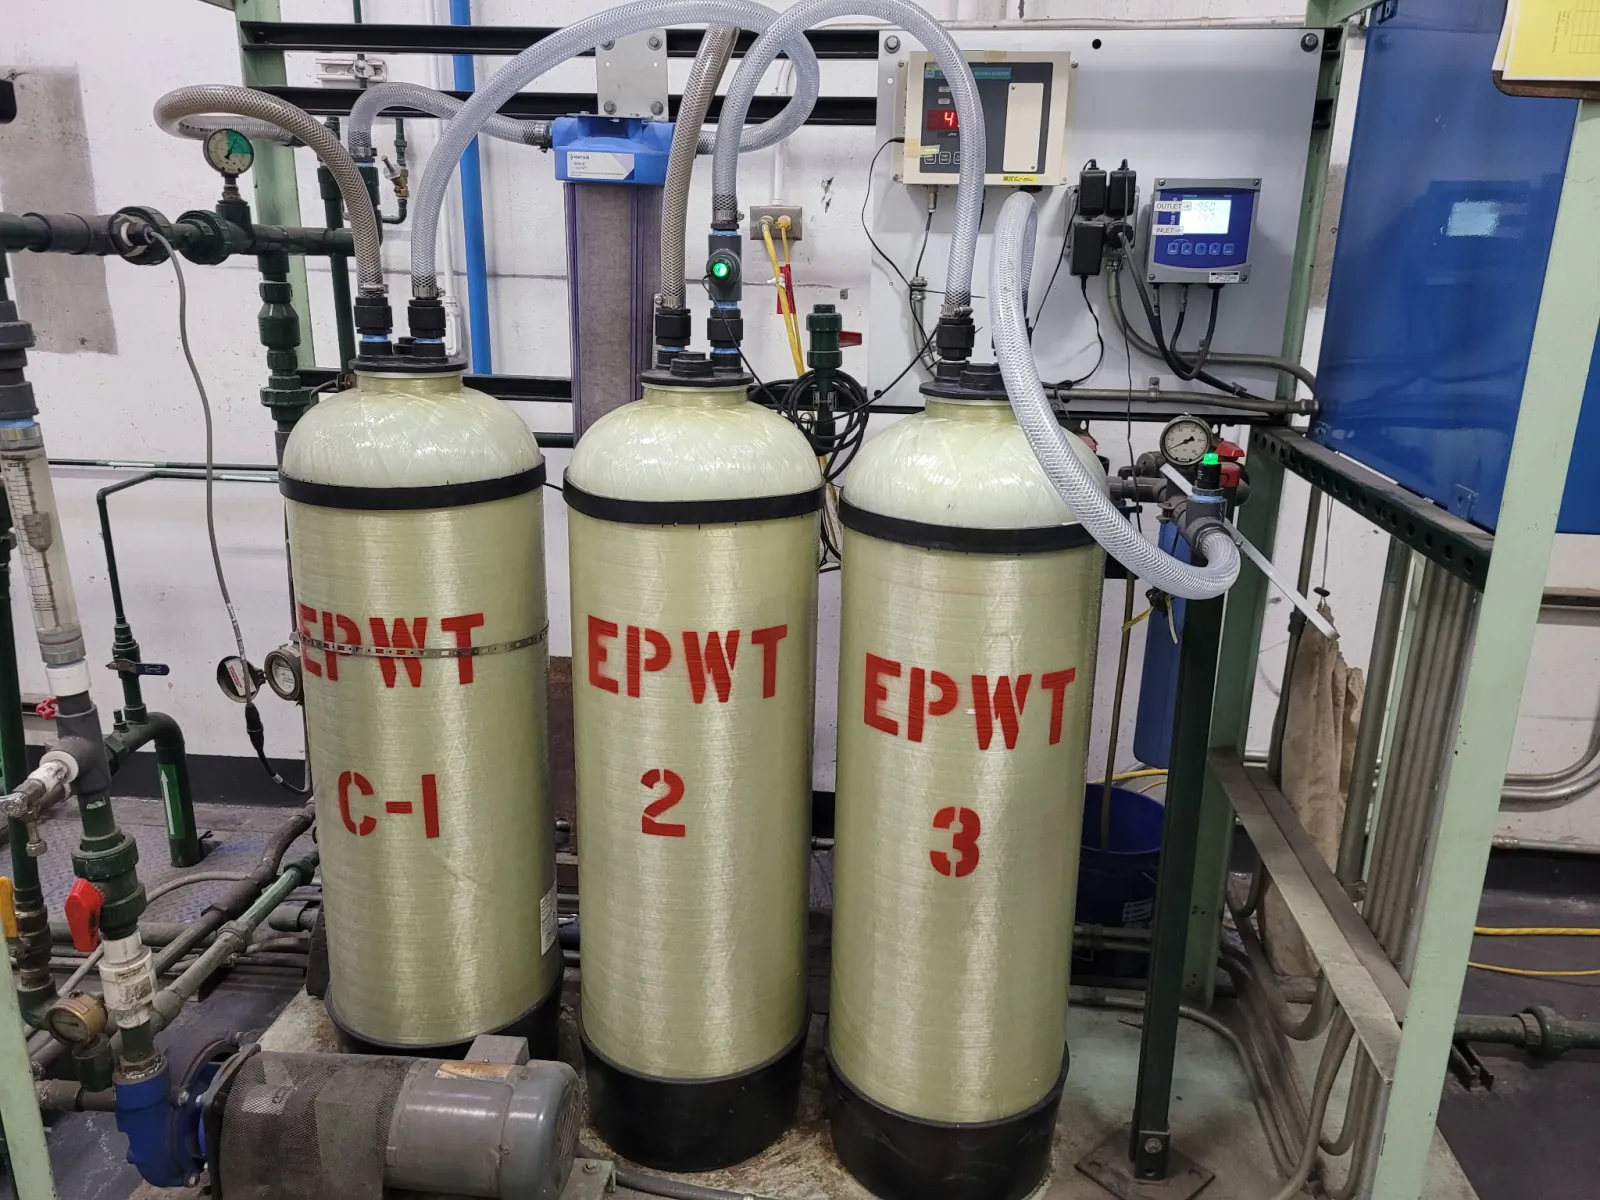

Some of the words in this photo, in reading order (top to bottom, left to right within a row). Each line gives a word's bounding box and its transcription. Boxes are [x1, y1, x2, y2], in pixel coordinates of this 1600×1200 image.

[1156, 226, 1175, 234] INLET
[1157, 202, 1182, 210] OUTLET
[299, 603, 484, 688] EPWT
[588, 614, 787, 704] EPWT
[864, 652, 1076, 750] EPWT
[641, 768, 685, 837] 2
[930, 806, 981, 878] 3
